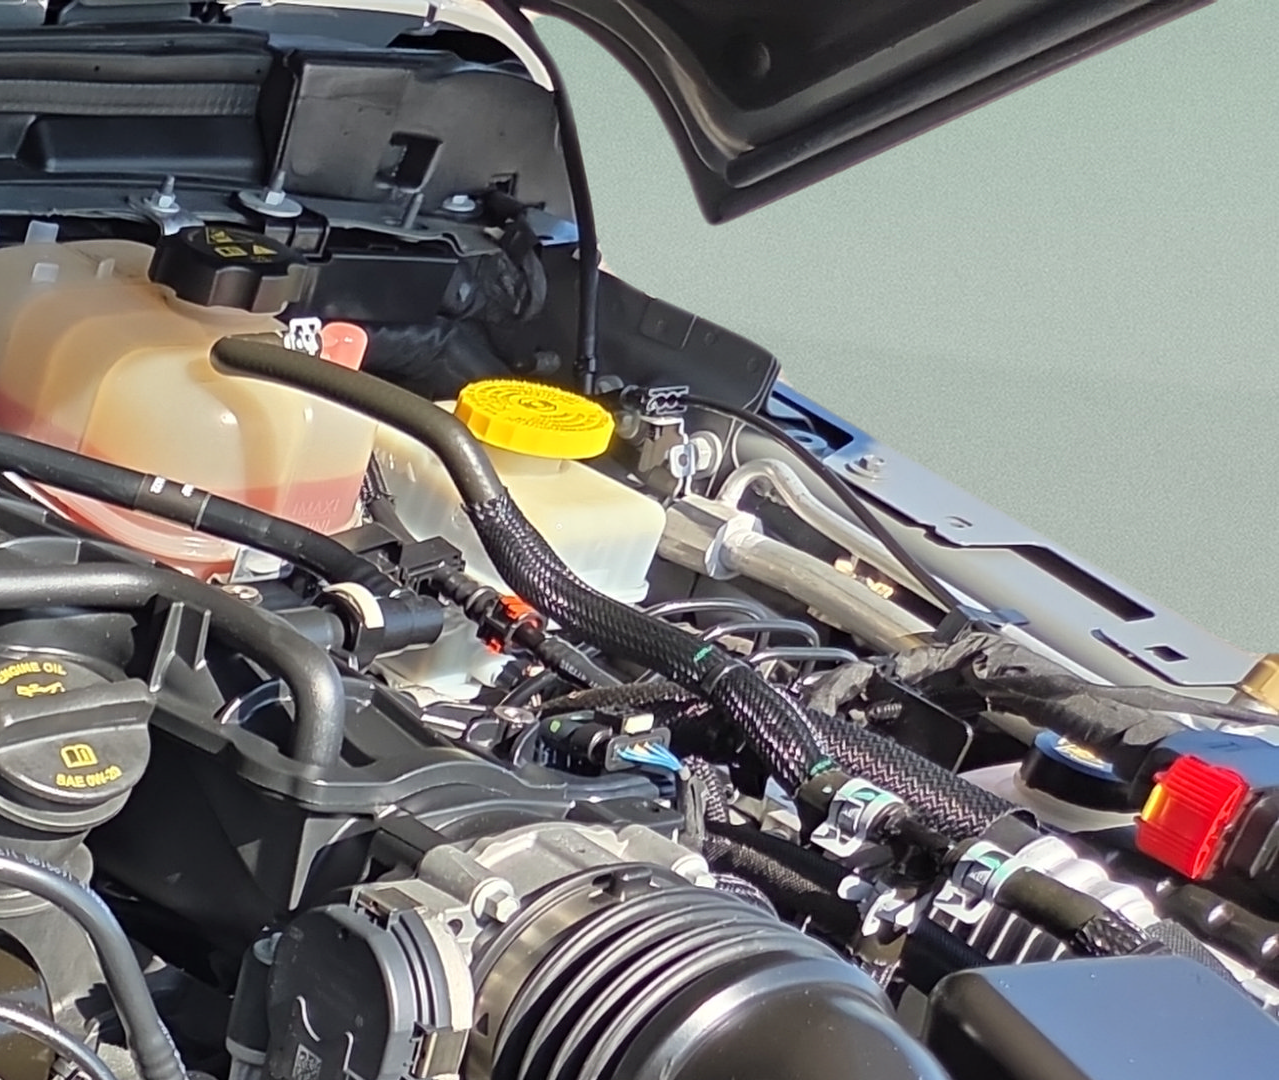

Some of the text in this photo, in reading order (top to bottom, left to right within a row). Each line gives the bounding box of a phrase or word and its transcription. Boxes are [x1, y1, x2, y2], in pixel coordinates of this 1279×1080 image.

[42, 662, 67, 676] OIL
[56, 765, 123, 788] SAE 0W-20
